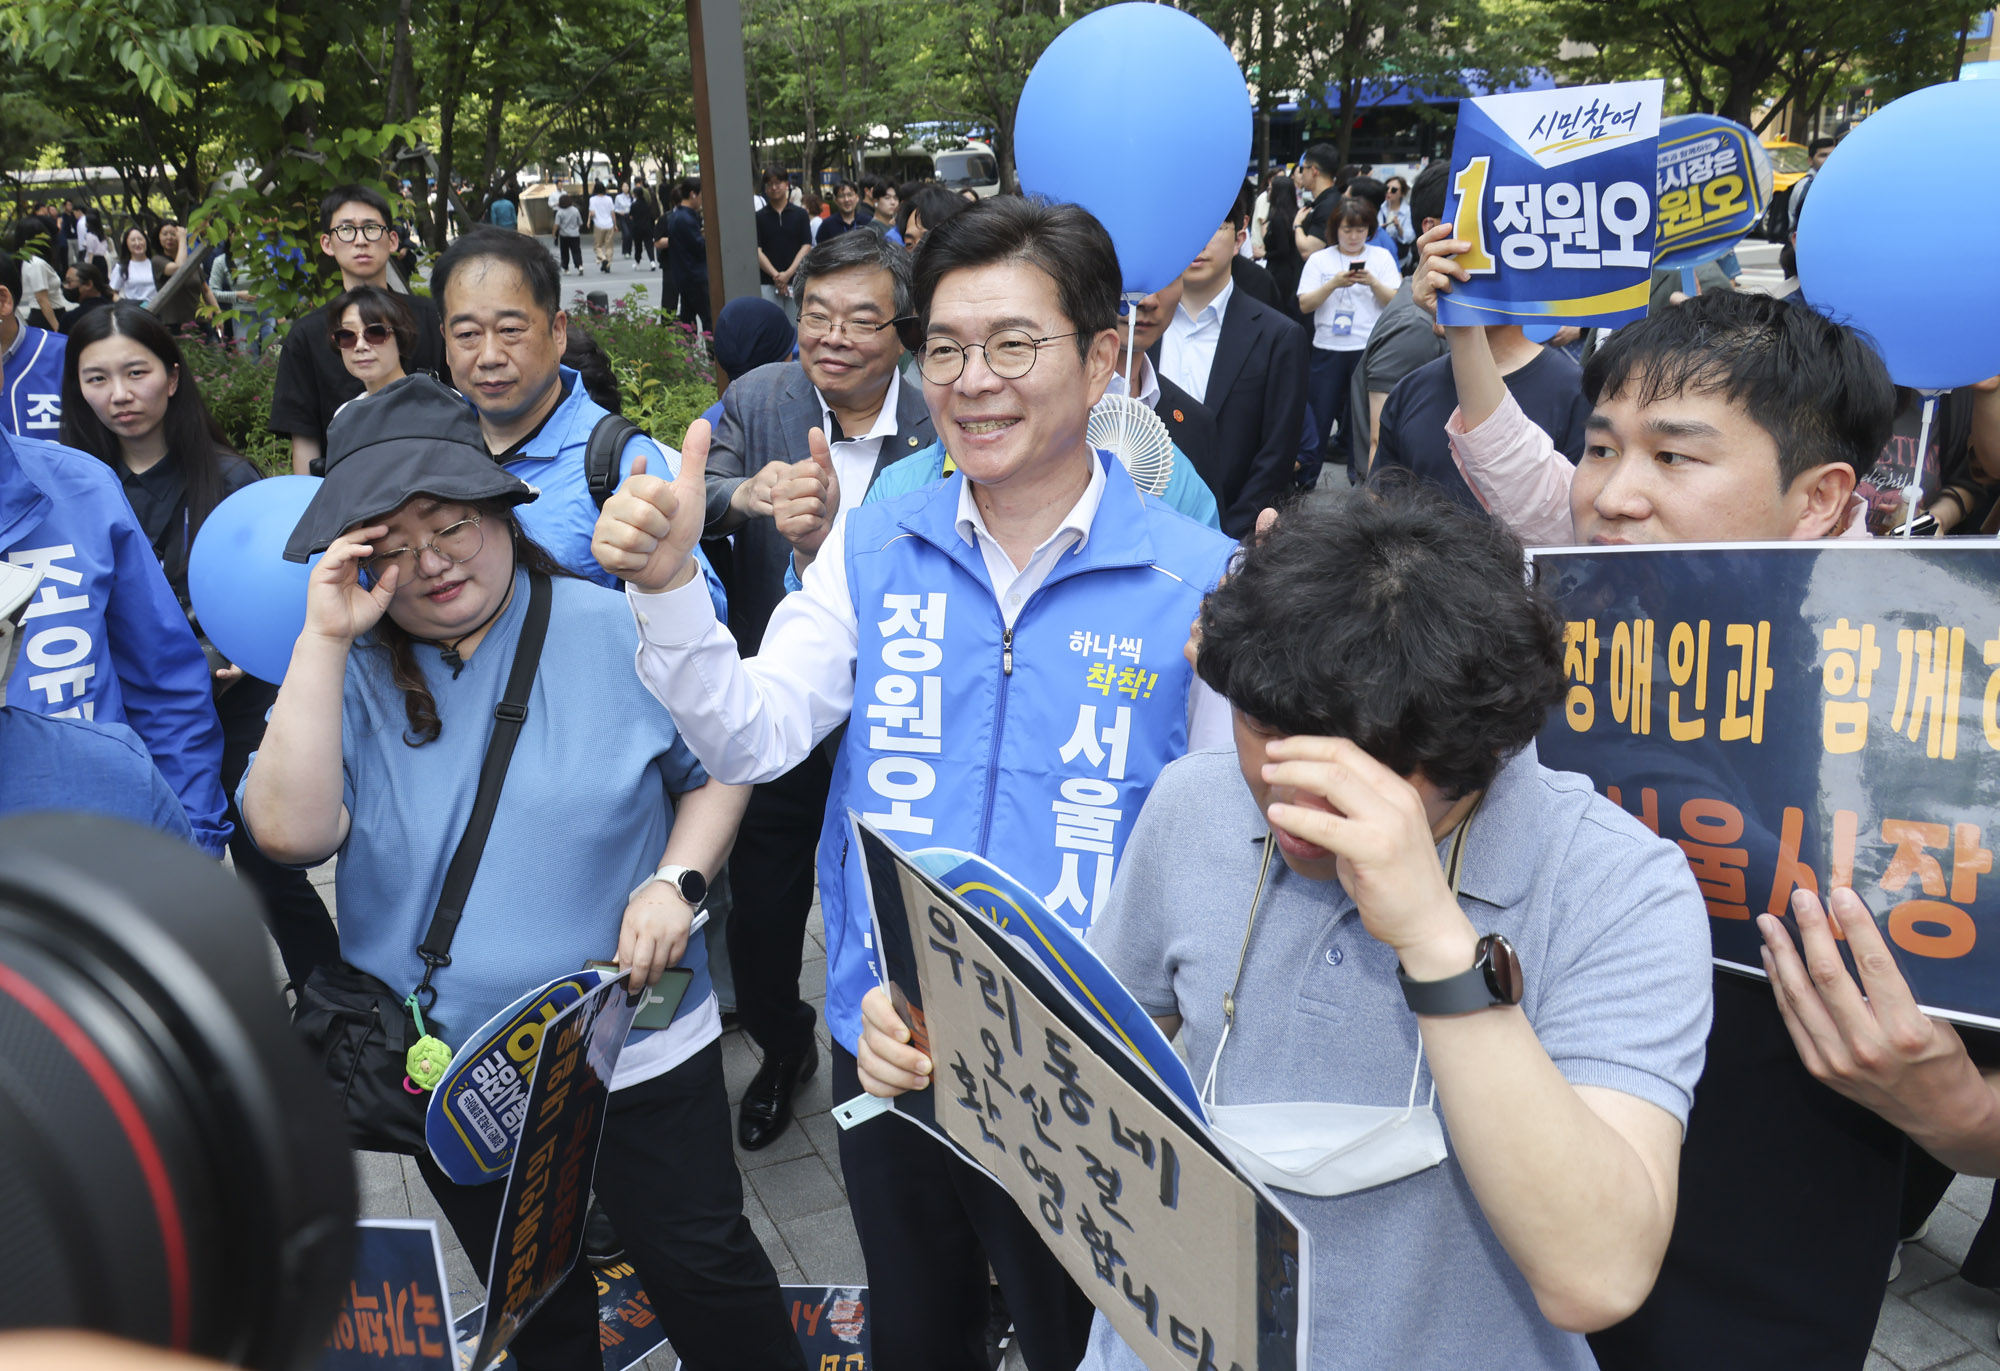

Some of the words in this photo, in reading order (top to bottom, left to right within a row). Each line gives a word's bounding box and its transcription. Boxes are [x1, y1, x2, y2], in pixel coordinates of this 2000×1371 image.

[1528, 98, 1642, 140] 시민참여
[1656, 148, 1738, 196] 시장은
[1493, 181, 1650, 269] 정원오
[1656, 174, 1748, 239] 원오
[1069, 630, 1143, 664] 하나씩
[866, 592, 947, 835] 정원오
[1086, 662, 1159, 700] 착착!
[1562, 618, 1774, 744] 장애인과
[1042, 704, 1122, 938] 서울시
